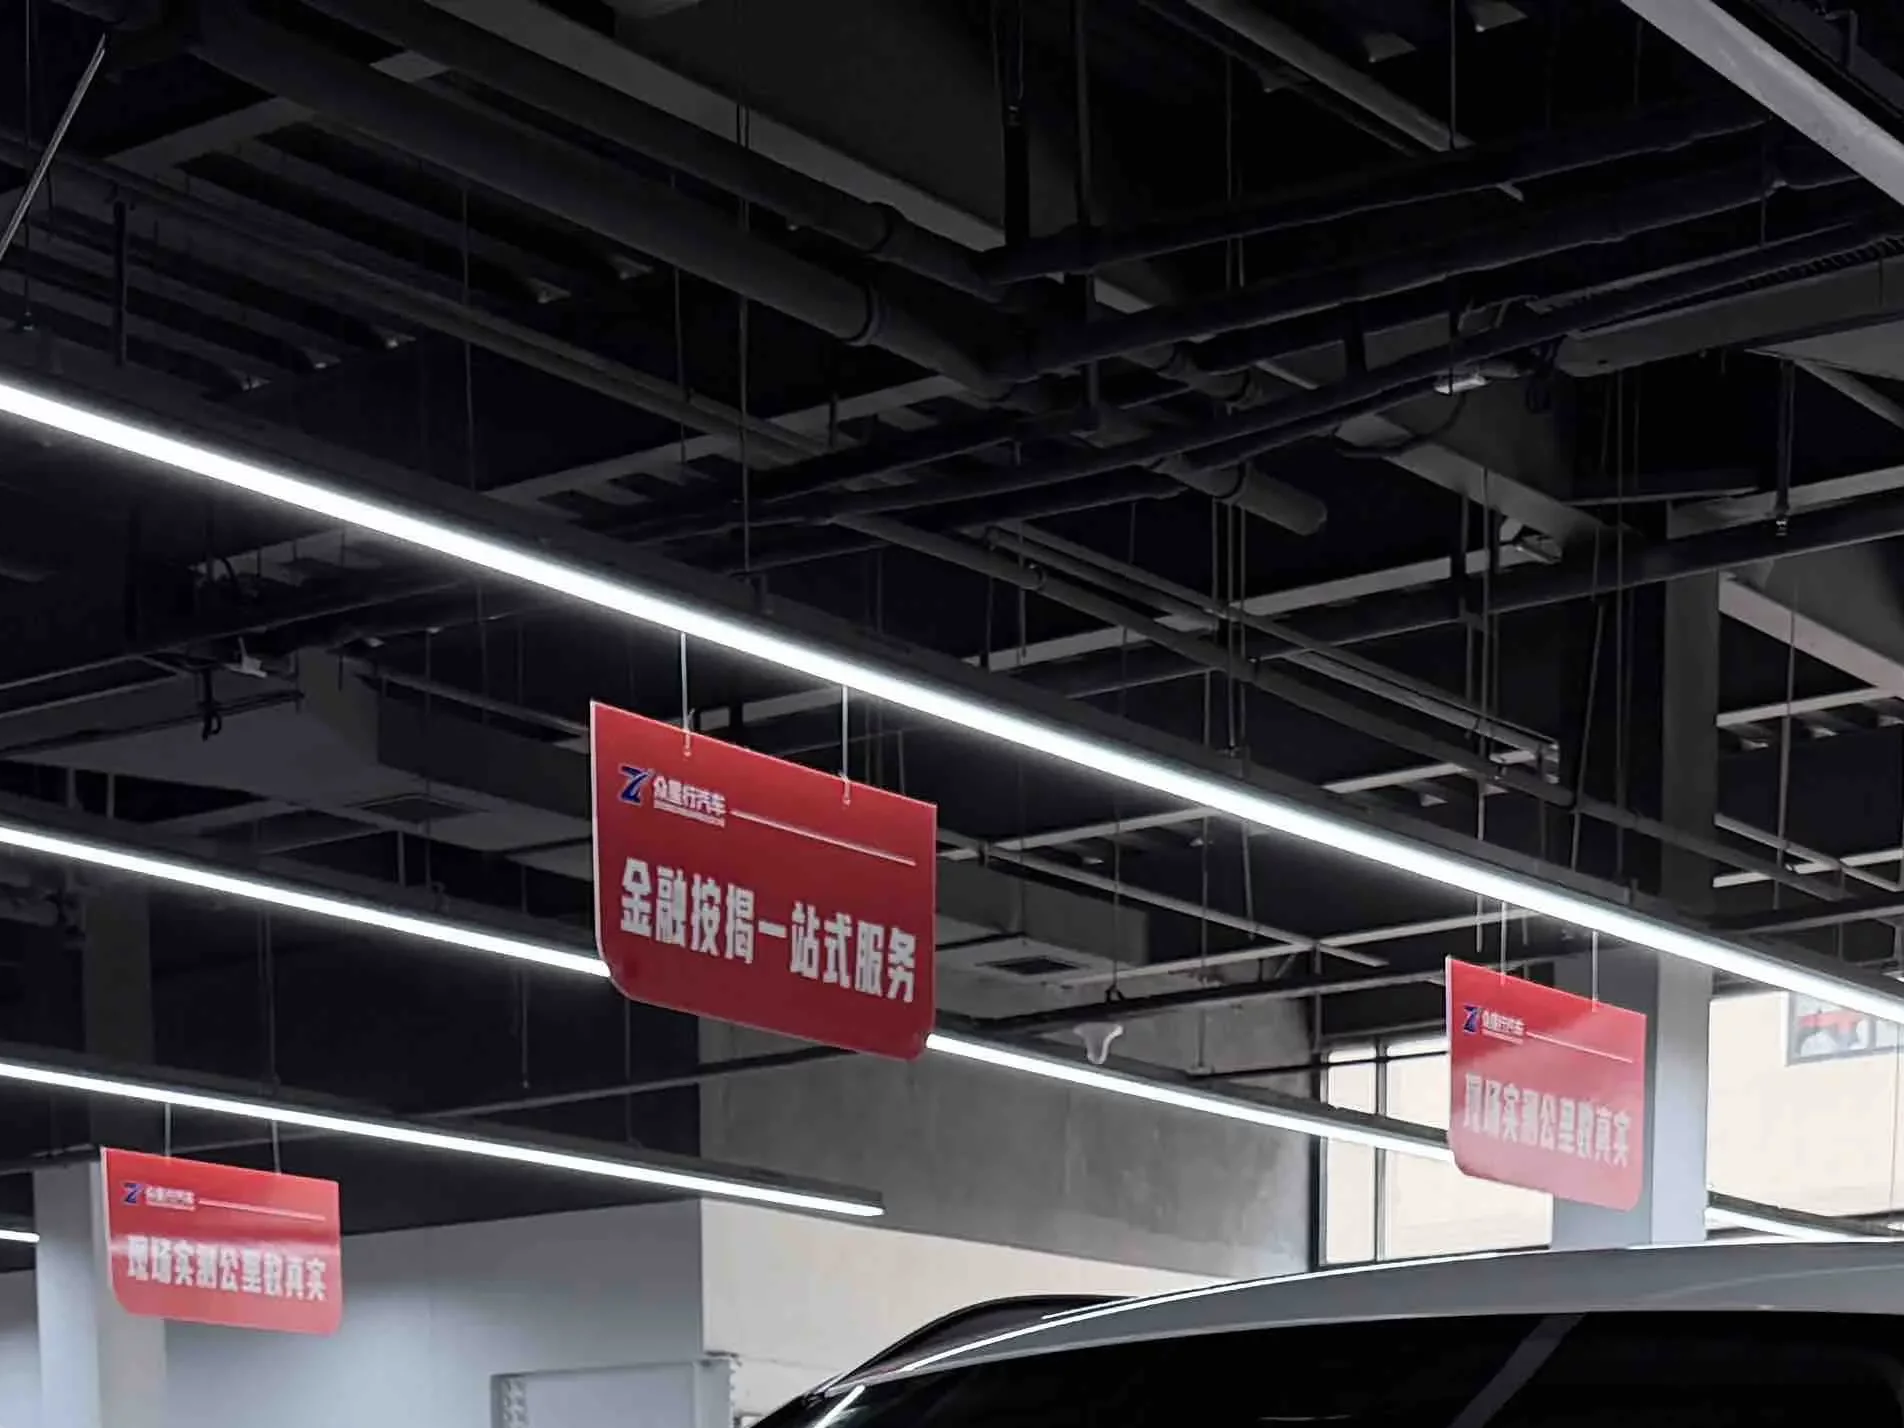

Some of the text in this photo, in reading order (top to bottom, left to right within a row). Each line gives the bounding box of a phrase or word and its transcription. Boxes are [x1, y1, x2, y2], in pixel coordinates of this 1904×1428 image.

[619, 856, 917, 1003] 金融按揭一站式服务
